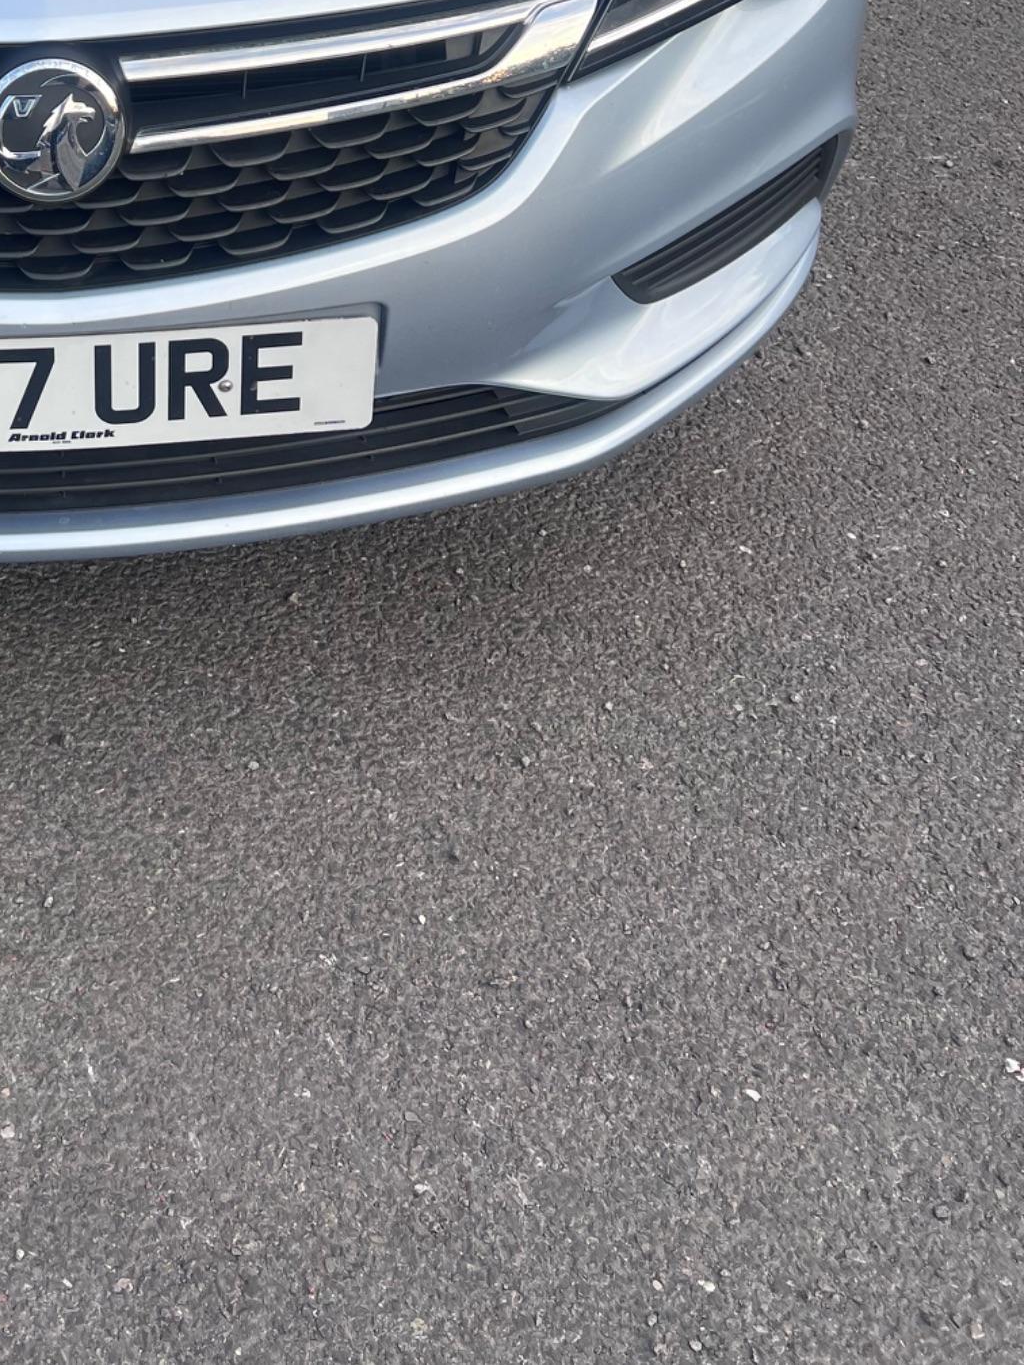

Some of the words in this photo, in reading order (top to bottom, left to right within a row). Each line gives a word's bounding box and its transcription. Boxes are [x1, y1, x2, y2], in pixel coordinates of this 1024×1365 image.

[94, 331, 303, 425] URE
[8, 432, 67, 442] Arnold
[71, 429, 115, 440] Clark
